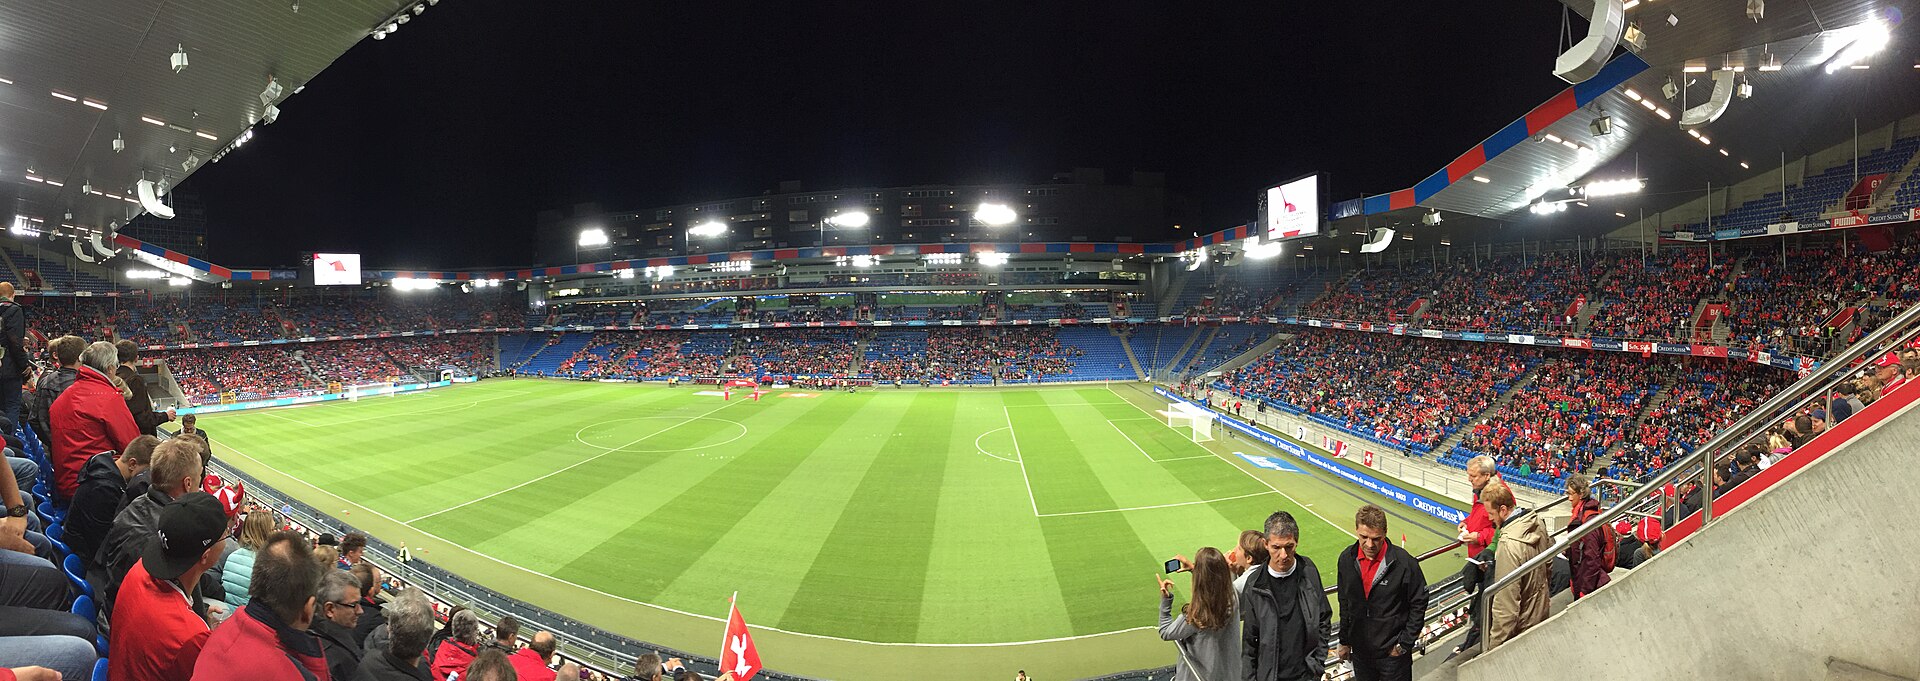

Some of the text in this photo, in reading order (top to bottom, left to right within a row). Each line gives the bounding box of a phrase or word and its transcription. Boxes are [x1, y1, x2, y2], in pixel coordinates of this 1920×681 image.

[1834, 216, 1855, 227] PUMA
[1412, 497, 1458, 523] CREDIT SUISSE
